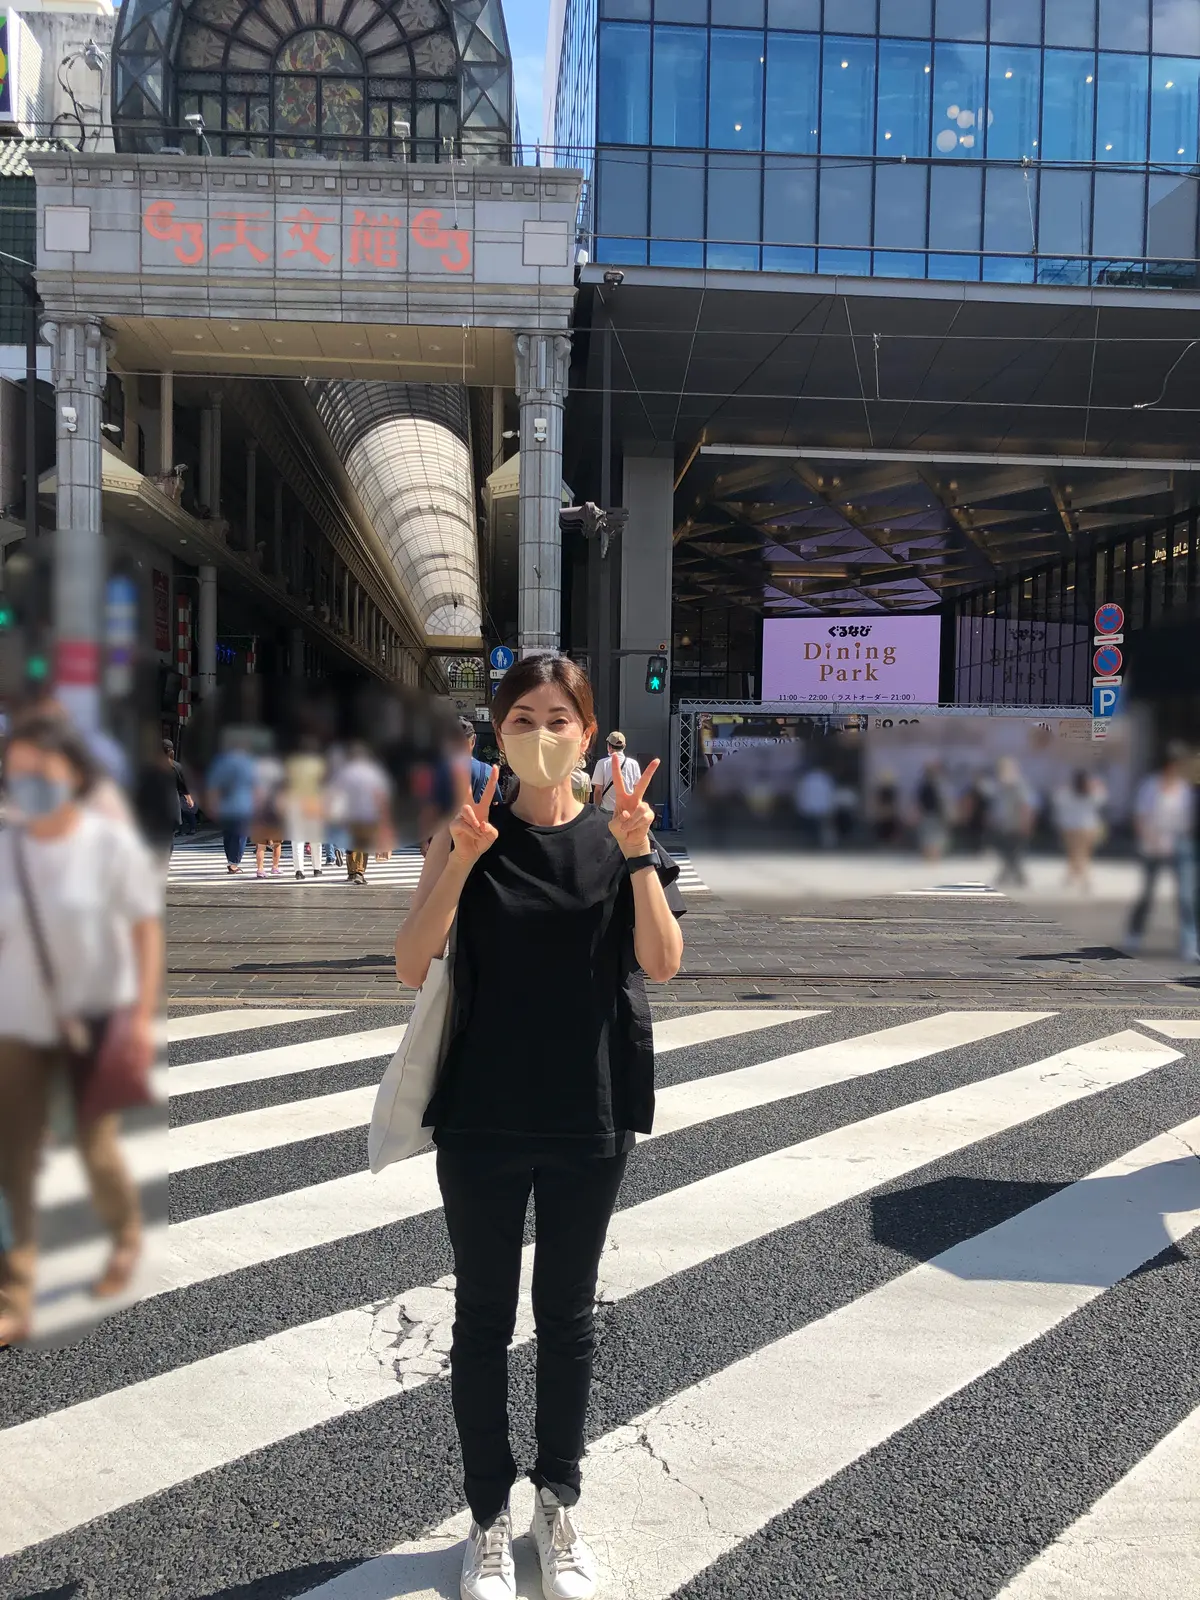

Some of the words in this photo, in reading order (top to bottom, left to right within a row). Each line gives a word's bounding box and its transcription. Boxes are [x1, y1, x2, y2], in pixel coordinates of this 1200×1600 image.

[211, 207, 400, 268] 天文館
[828, 625, 873, 638] ぐるなび
[803, 641, 897, 665] Dining
[819, 662, 880, 682] Park
[1099, 689, 1116, 715] P
